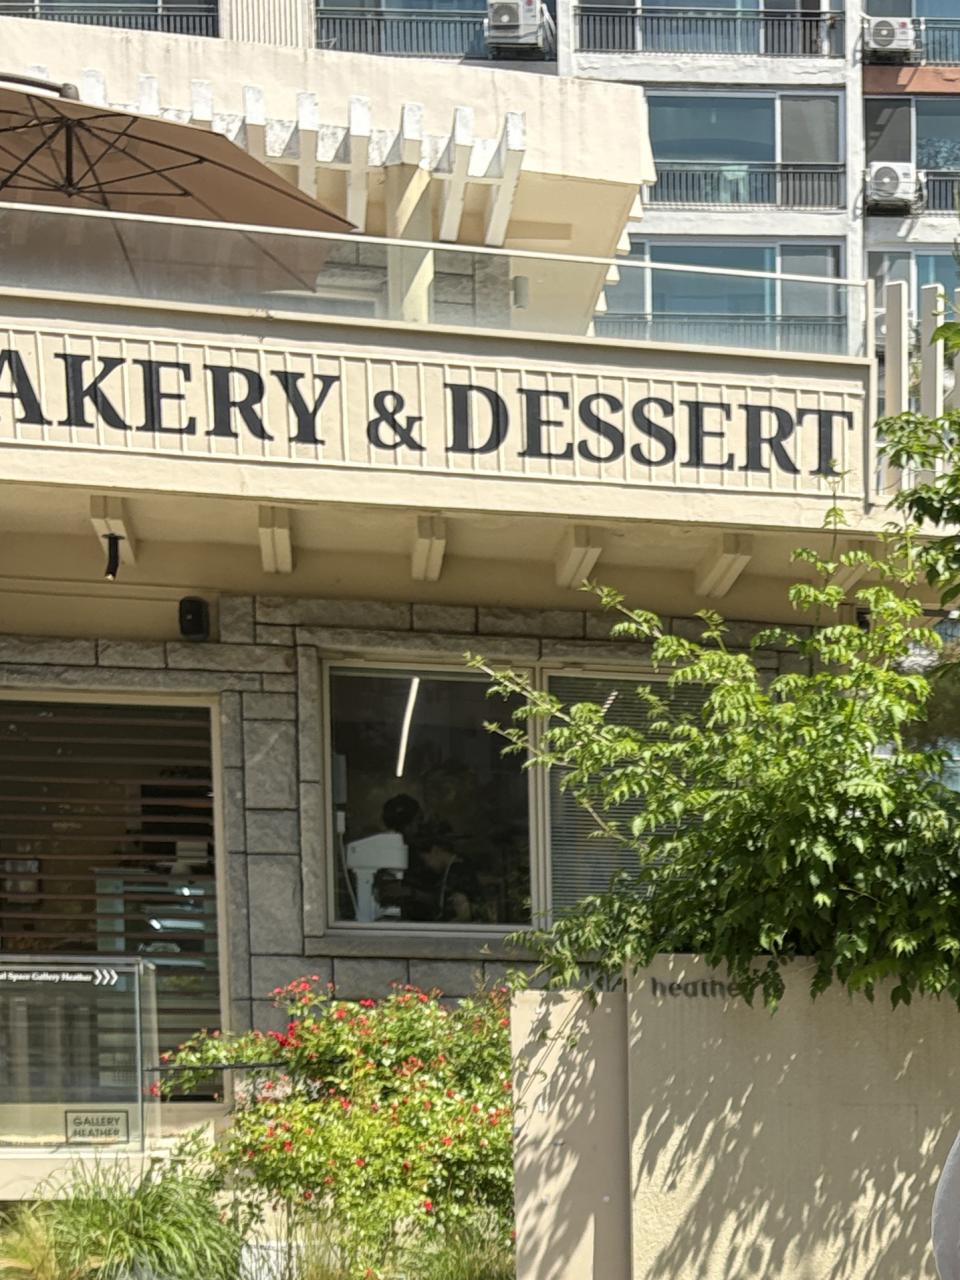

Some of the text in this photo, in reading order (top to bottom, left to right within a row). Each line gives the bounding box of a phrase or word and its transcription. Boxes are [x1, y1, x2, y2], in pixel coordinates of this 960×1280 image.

[0, 348, 854, 477] AKERY & DESSERT
[651, 977, 744, 998] heathe
[73, 1116, 120, 1126] GALLERY
[73, 1128, 120, 1137] HEATHER
